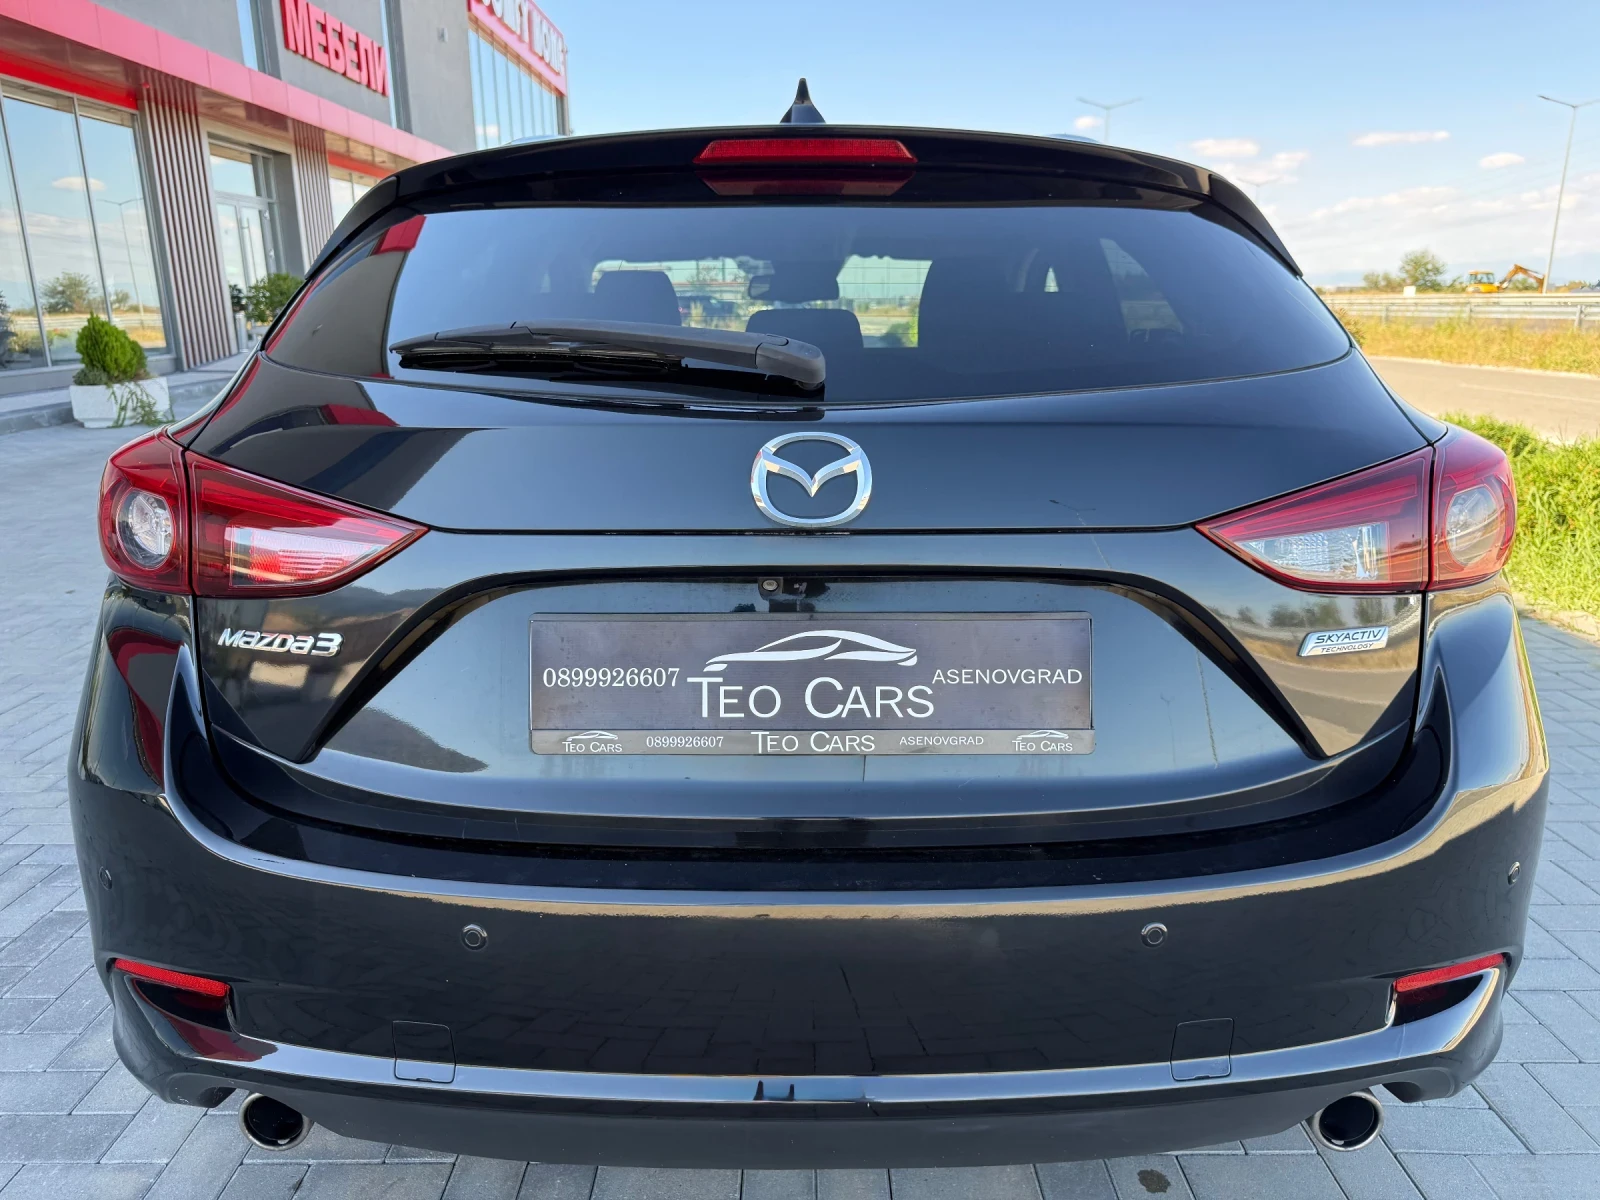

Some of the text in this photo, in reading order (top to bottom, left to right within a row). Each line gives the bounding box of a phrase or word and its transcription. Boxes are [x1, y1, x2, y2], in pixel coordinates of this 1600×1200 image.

[280, 0, 389, 97] МЕБЕЛИ
[1314, 629, 1381, 644] SKYACTIV
[1320, 642, 1374, 653] TECHNOLOGY
[542, 667, 680, 688] 0899926607
[932, 668, 1083, 685] ASENOVGRAD
[646, 736, 724, 748] 0899926607
[899, 736, 984, 746] ASENOVGRAD
